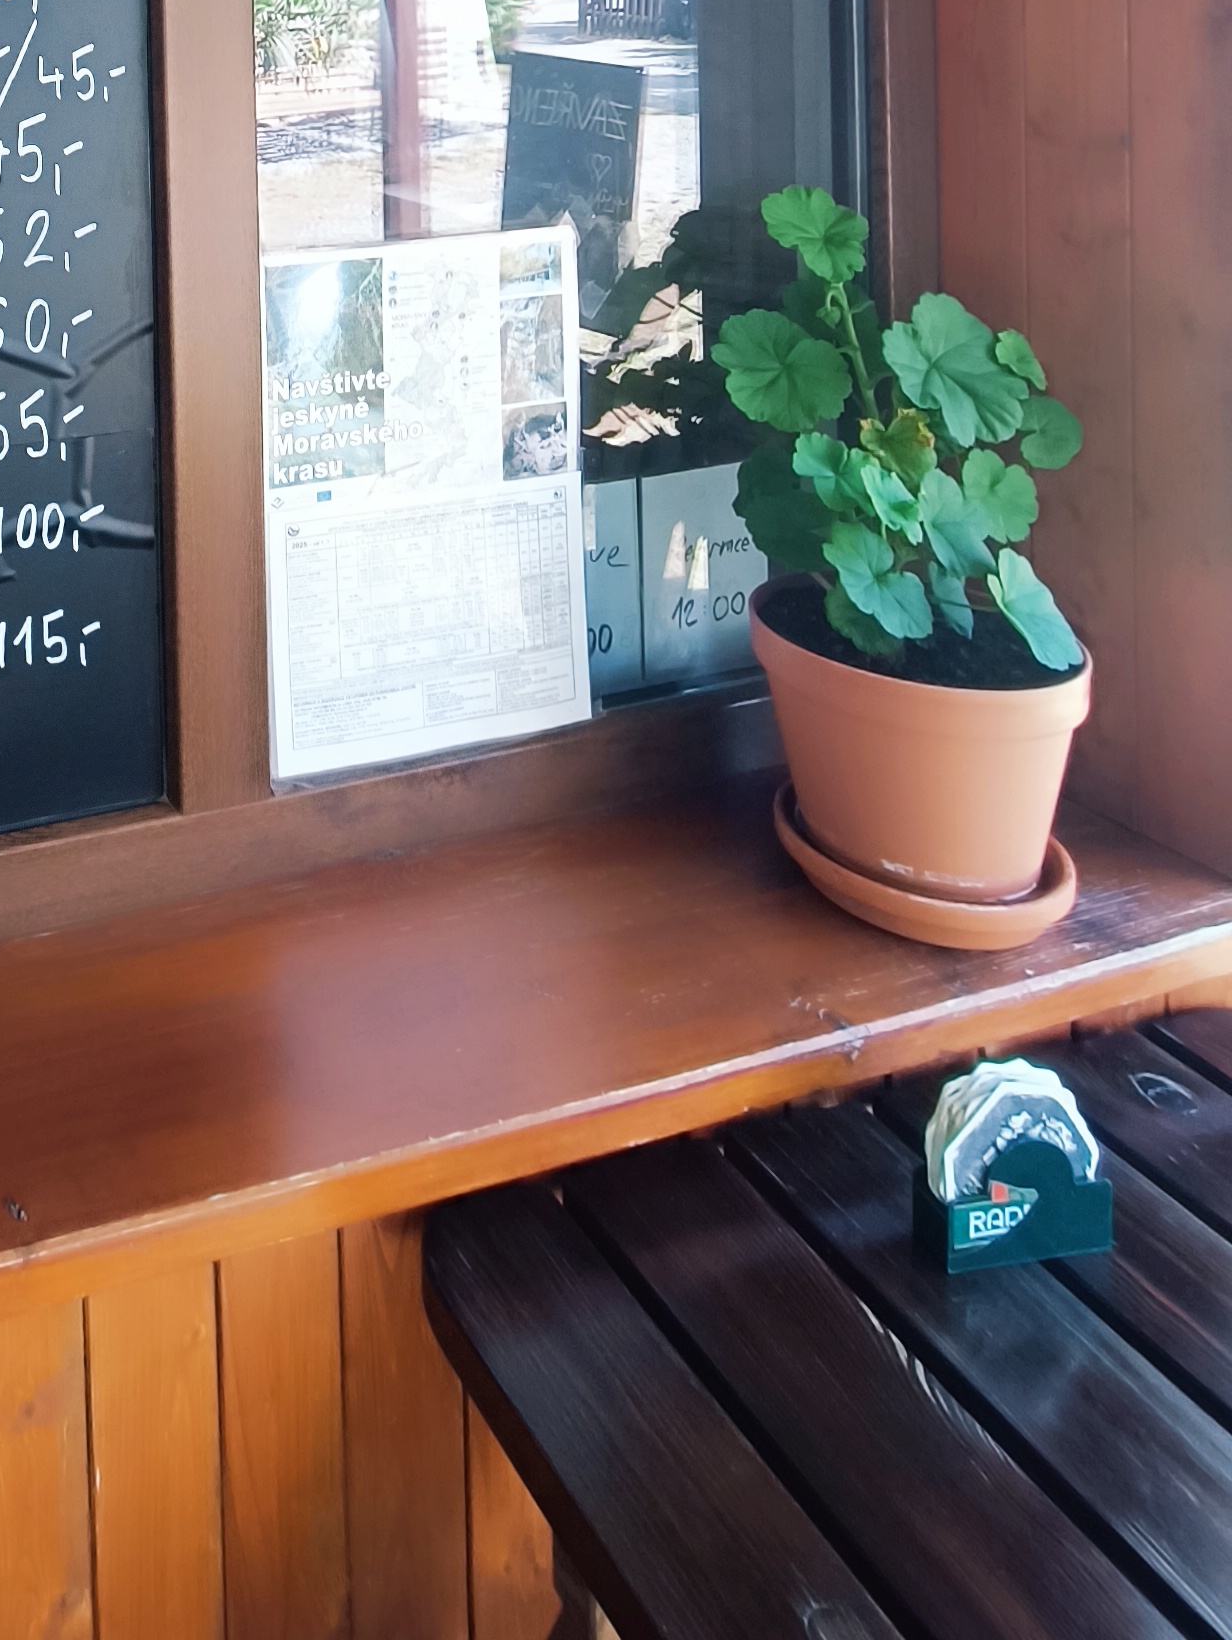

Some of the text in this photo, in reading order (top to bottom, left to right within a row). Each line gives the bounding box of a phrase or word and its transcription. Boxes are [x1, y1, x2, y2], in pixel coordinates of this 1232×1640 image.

[271, 368, 391, 402] Navštivte
[270, 396, 370, 435] jeskyně
[272, 419, 424, 458] Moravského
[272, 458, 344, 486] krasu
